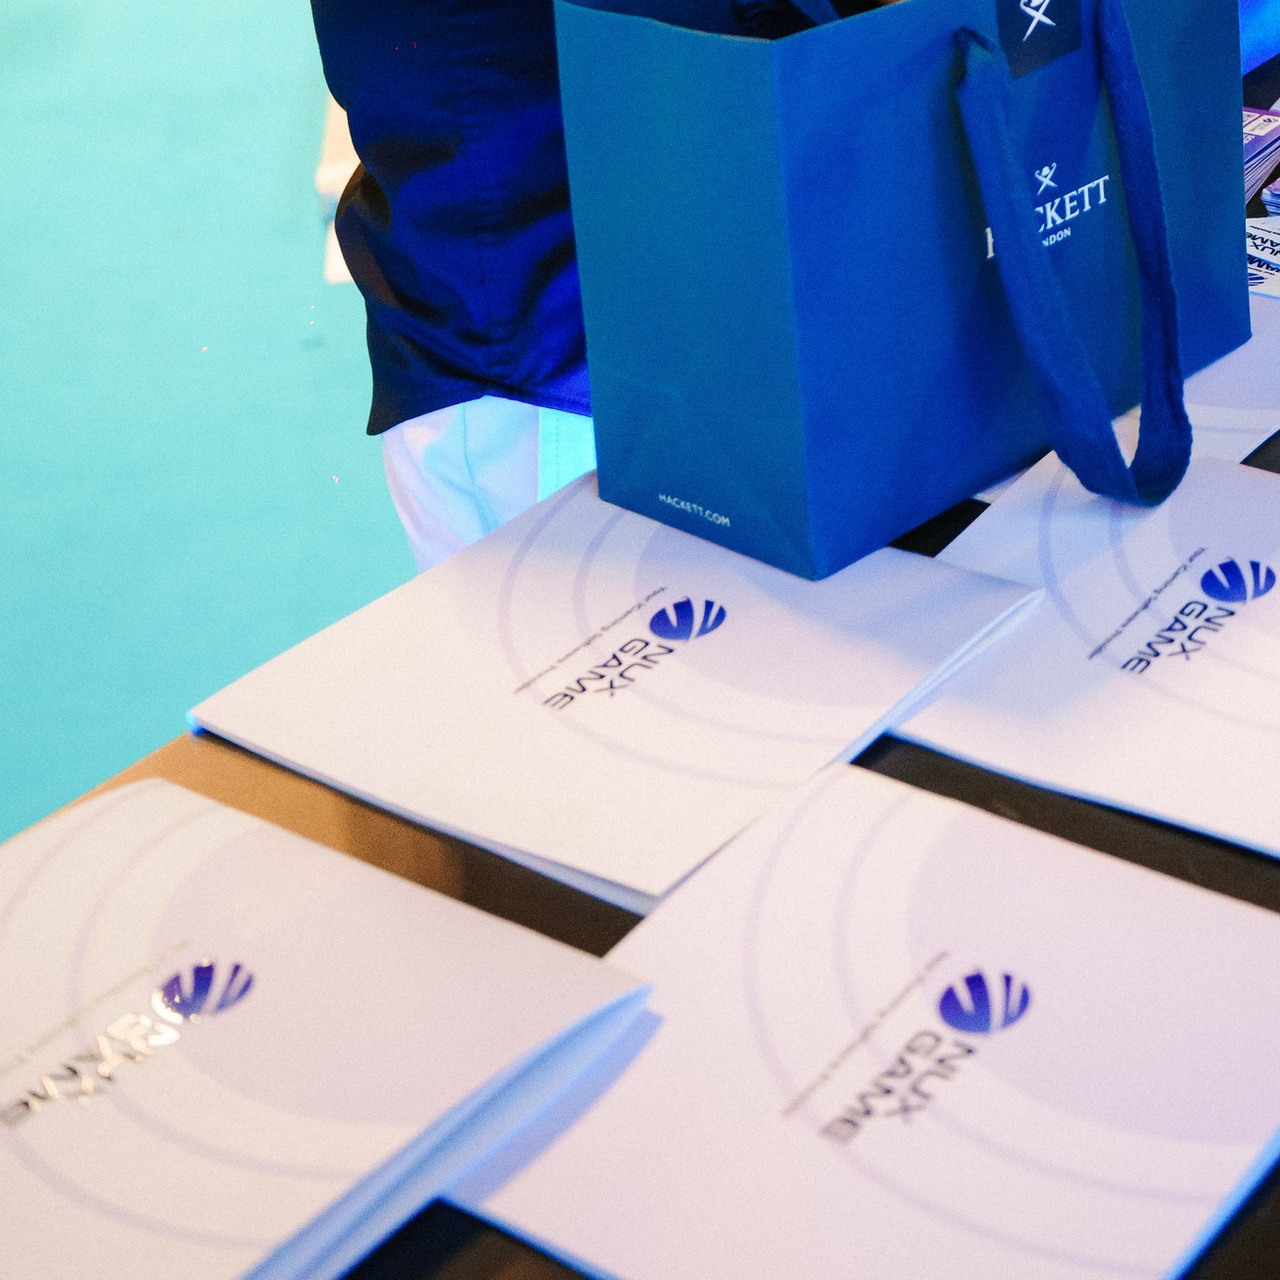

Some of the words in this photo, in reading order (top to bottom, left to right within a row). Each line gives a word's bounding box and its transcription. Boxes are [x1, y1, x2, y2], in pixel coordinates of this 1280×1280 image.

[658, 492, 731, 528] HACKETT.COM
[1121, 600, 1208, 674] GAME
[1167, 606, 1235, 660] NUX
[543, 637, 650, 710] GAME
[593, 644, 675, 697] NUX
[819, 1028, 943, 1143] GAME
[884, 1039, 977, 1124] NUX
